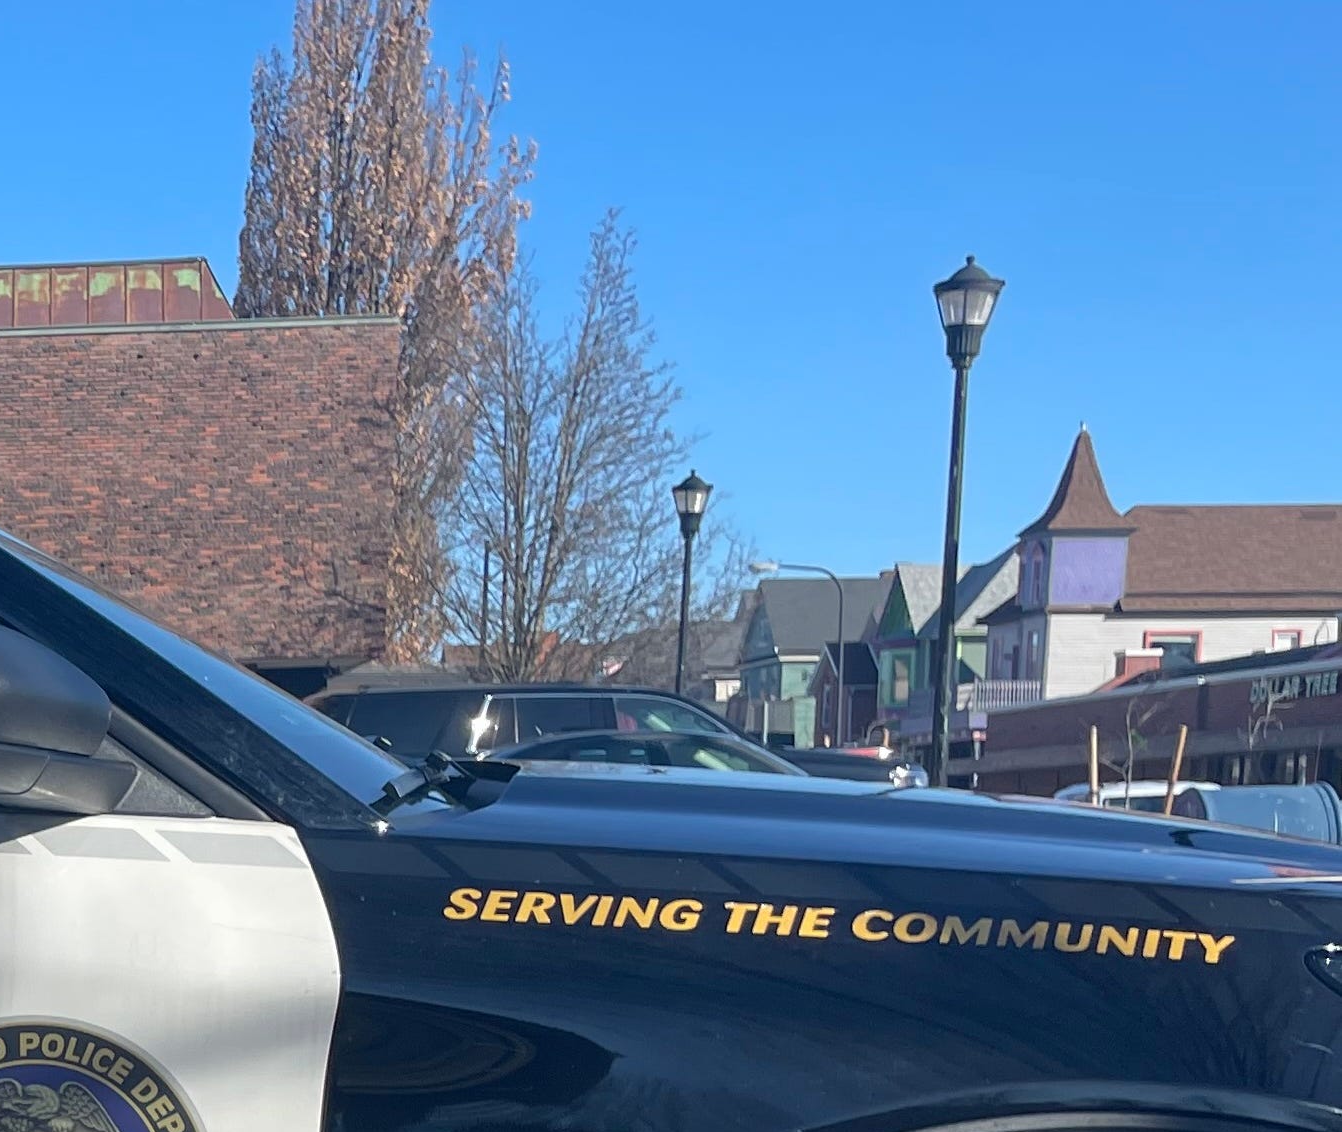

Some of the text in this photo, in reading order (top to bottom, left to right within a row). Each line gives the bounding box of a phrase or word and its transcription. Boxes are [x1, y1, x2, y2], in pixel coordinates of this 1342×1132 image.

[1305, 671, 1338, 698] TREE
[443, 887, 1236, 964] SERVING THE COMMUNITY
[19, 1032, 134, 1085] POLICE
